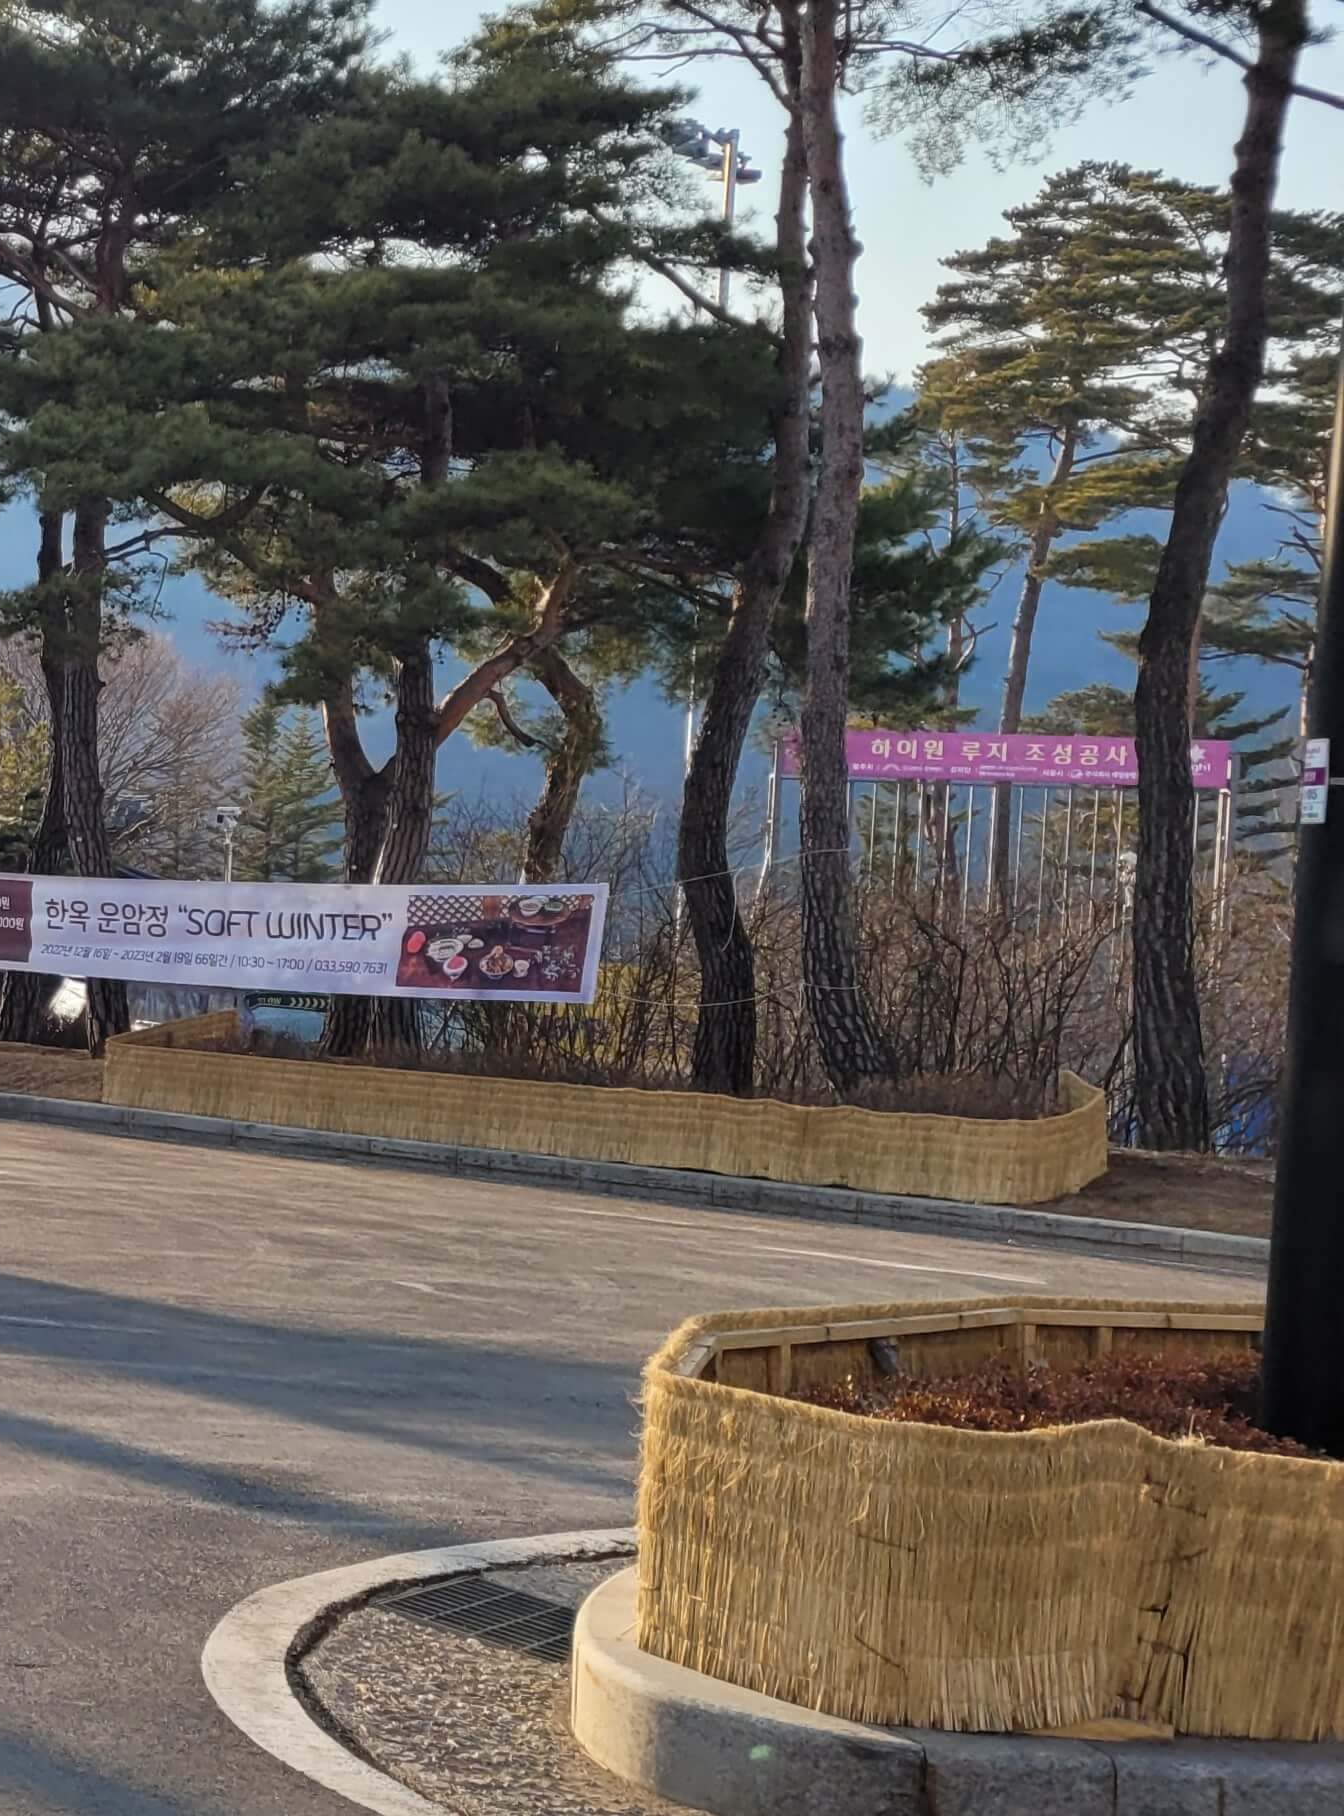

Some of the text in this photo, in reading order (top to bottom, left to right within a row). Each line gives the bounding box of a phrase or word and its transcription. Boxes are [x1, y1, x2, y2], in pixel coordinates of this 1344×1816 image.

[871, 738, 1128, 766] 하이원 루지 조성공사
[45, 898, 91, 933] 한옥
[96, 902, 169, 938] 운암정
[120, 950, 154, 963] 2023년
[156, 951, 170, 964] 2월
[174, 952, 193, 965] 19일
[195, 953, 229, 967] 66일간
[238, 955, 265, 968] 10:30
[276, 958, 304, 971] 17:00
